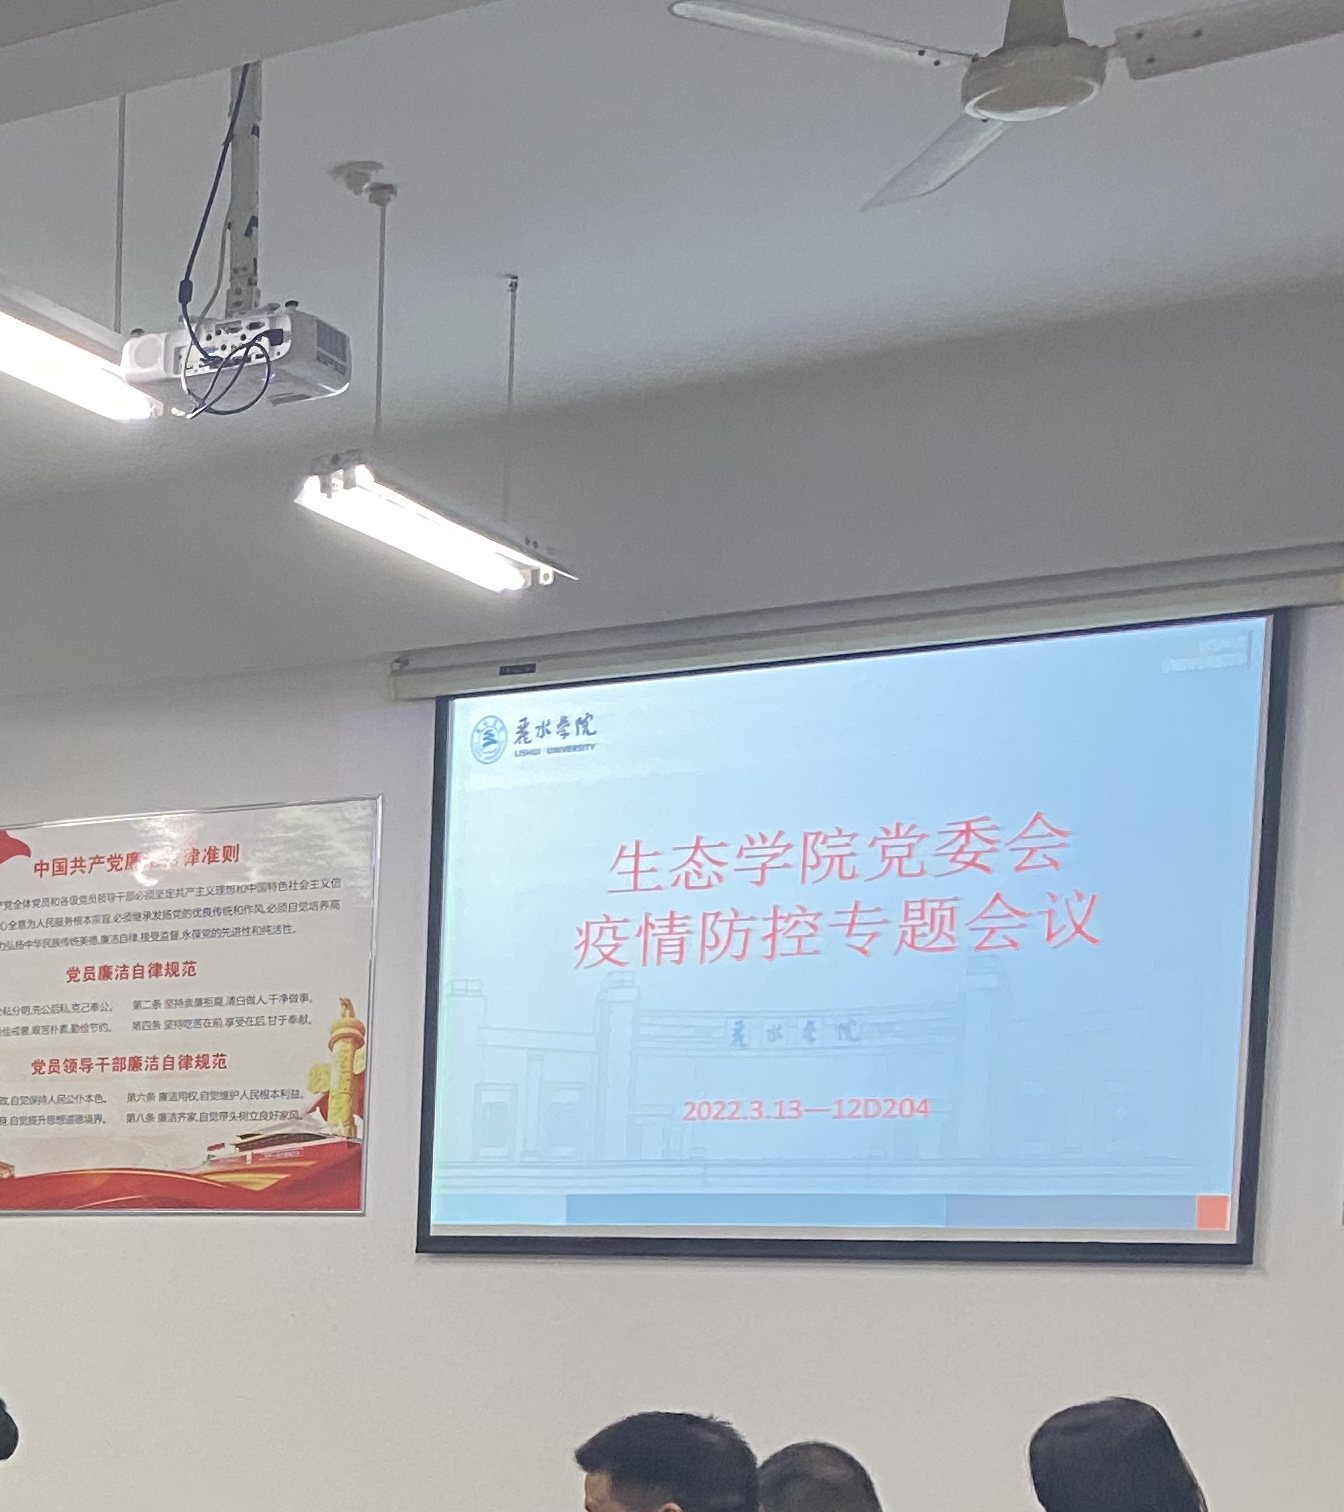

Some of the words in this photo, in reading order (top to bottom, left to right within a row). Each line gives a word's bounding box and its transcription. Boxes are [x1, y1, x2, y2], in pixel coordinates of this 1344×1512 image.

[33, 843, 240, 879] 中国共产党廉律准则
[605, 808, 1074, 896] 生态学院党委会
[572, 887, 1103, 972] 疫情防控专题会议
[65, 960, 198, 984] 党员廉洁自律规范
[31, 1052, 228, 1076] 党员领导干部廉洁自律规范
